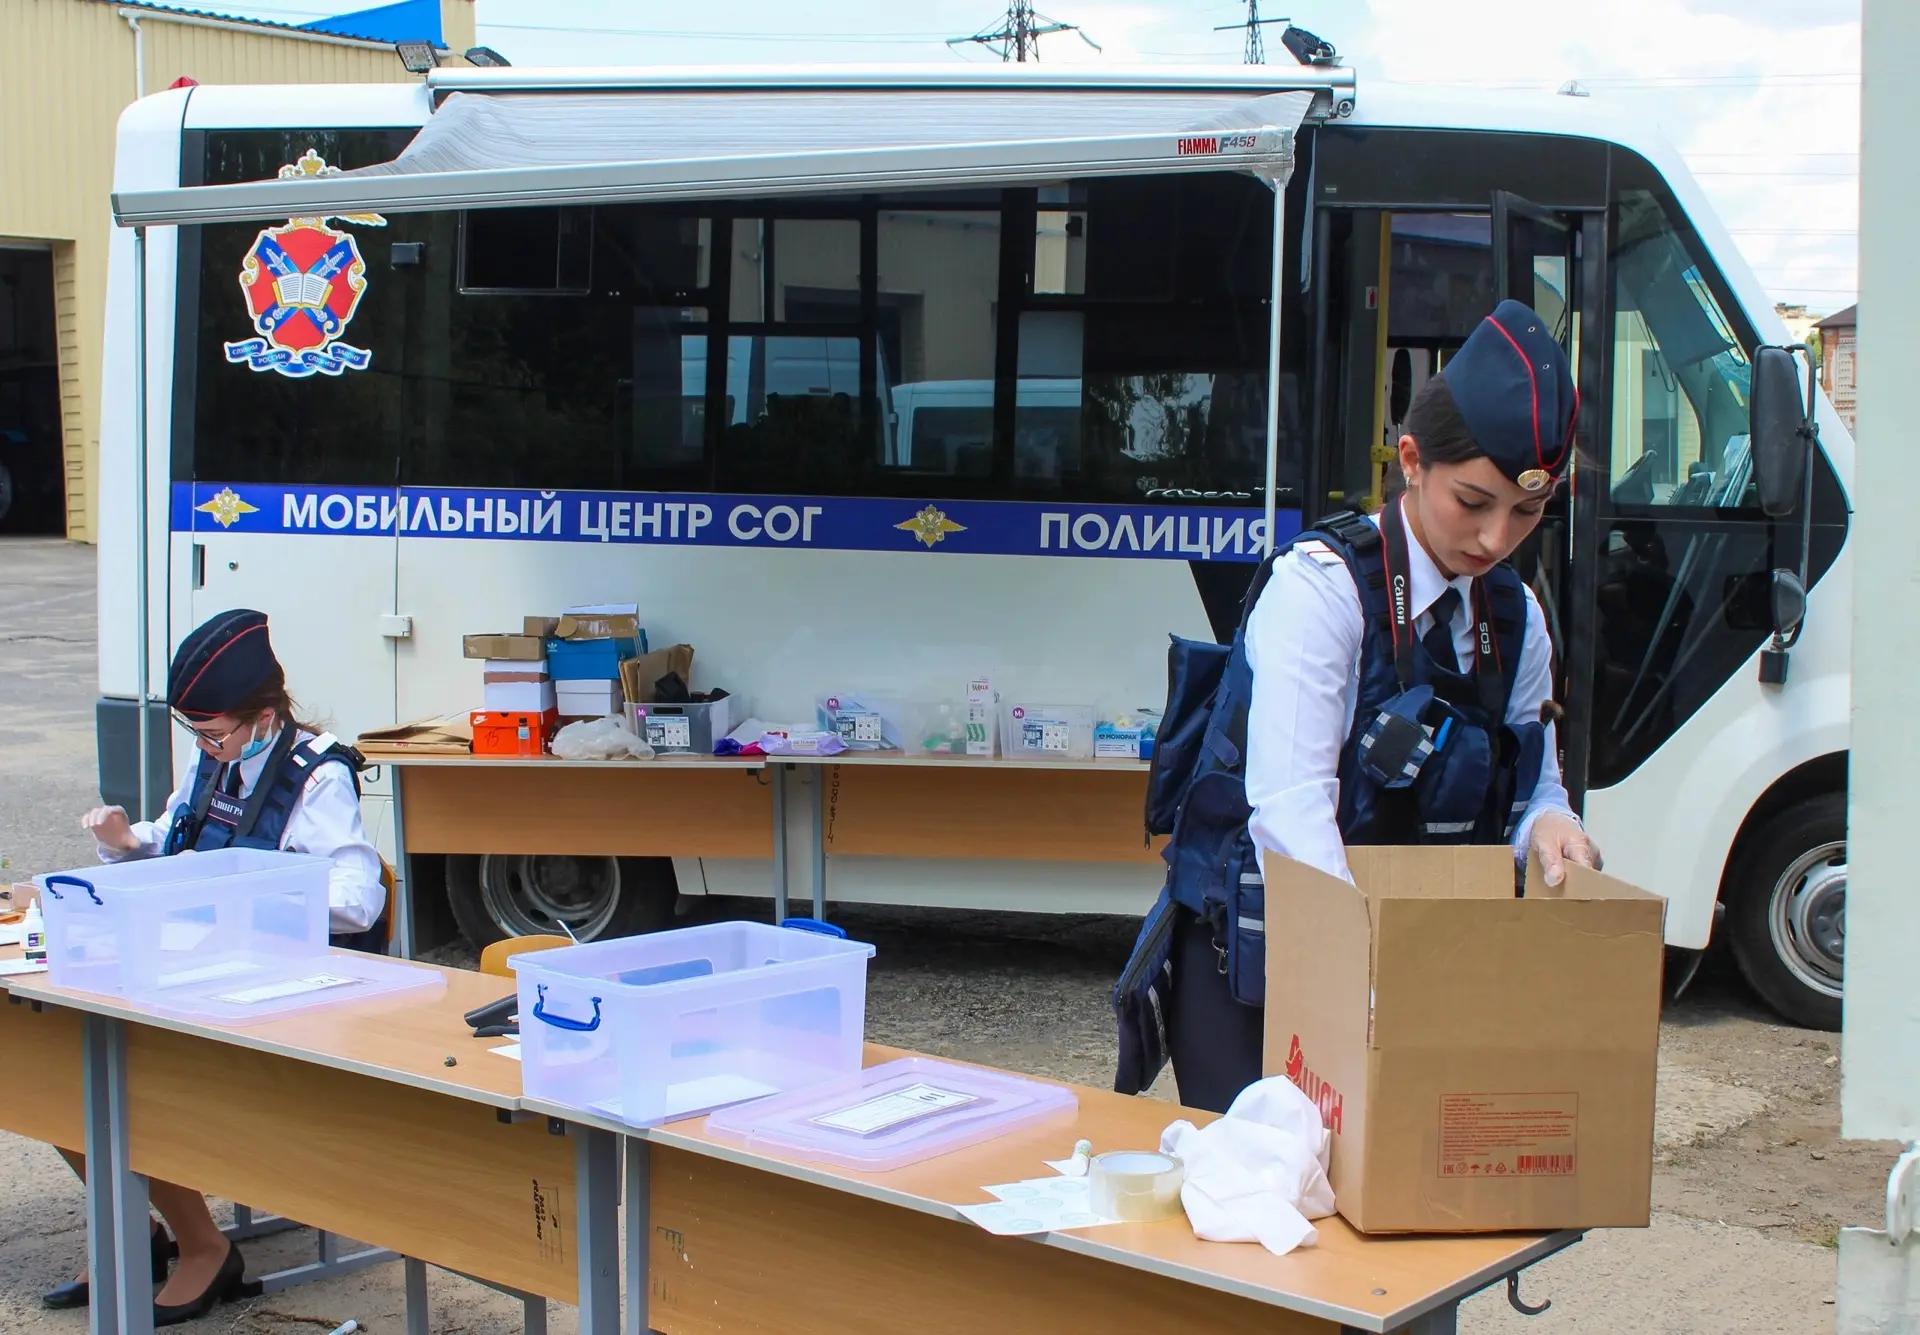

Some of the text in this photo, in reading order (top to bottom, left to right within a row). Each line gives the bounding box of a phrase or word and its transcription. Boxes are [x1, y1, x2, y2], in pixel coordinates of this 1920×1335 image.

[1178, 138, 1217, 155] FIAMMA
[258, 352, 286, 364] РОССИИ
[282, 490, 823, 543] МОБИЛЬНЫЙ ЦЕНТР СОГ
[1040, 512, 1267, 560] ПОЛИЦИЯ
[1393, 574, 1405, 625] Canon
[1480, 622, 1491, 654] EOS
